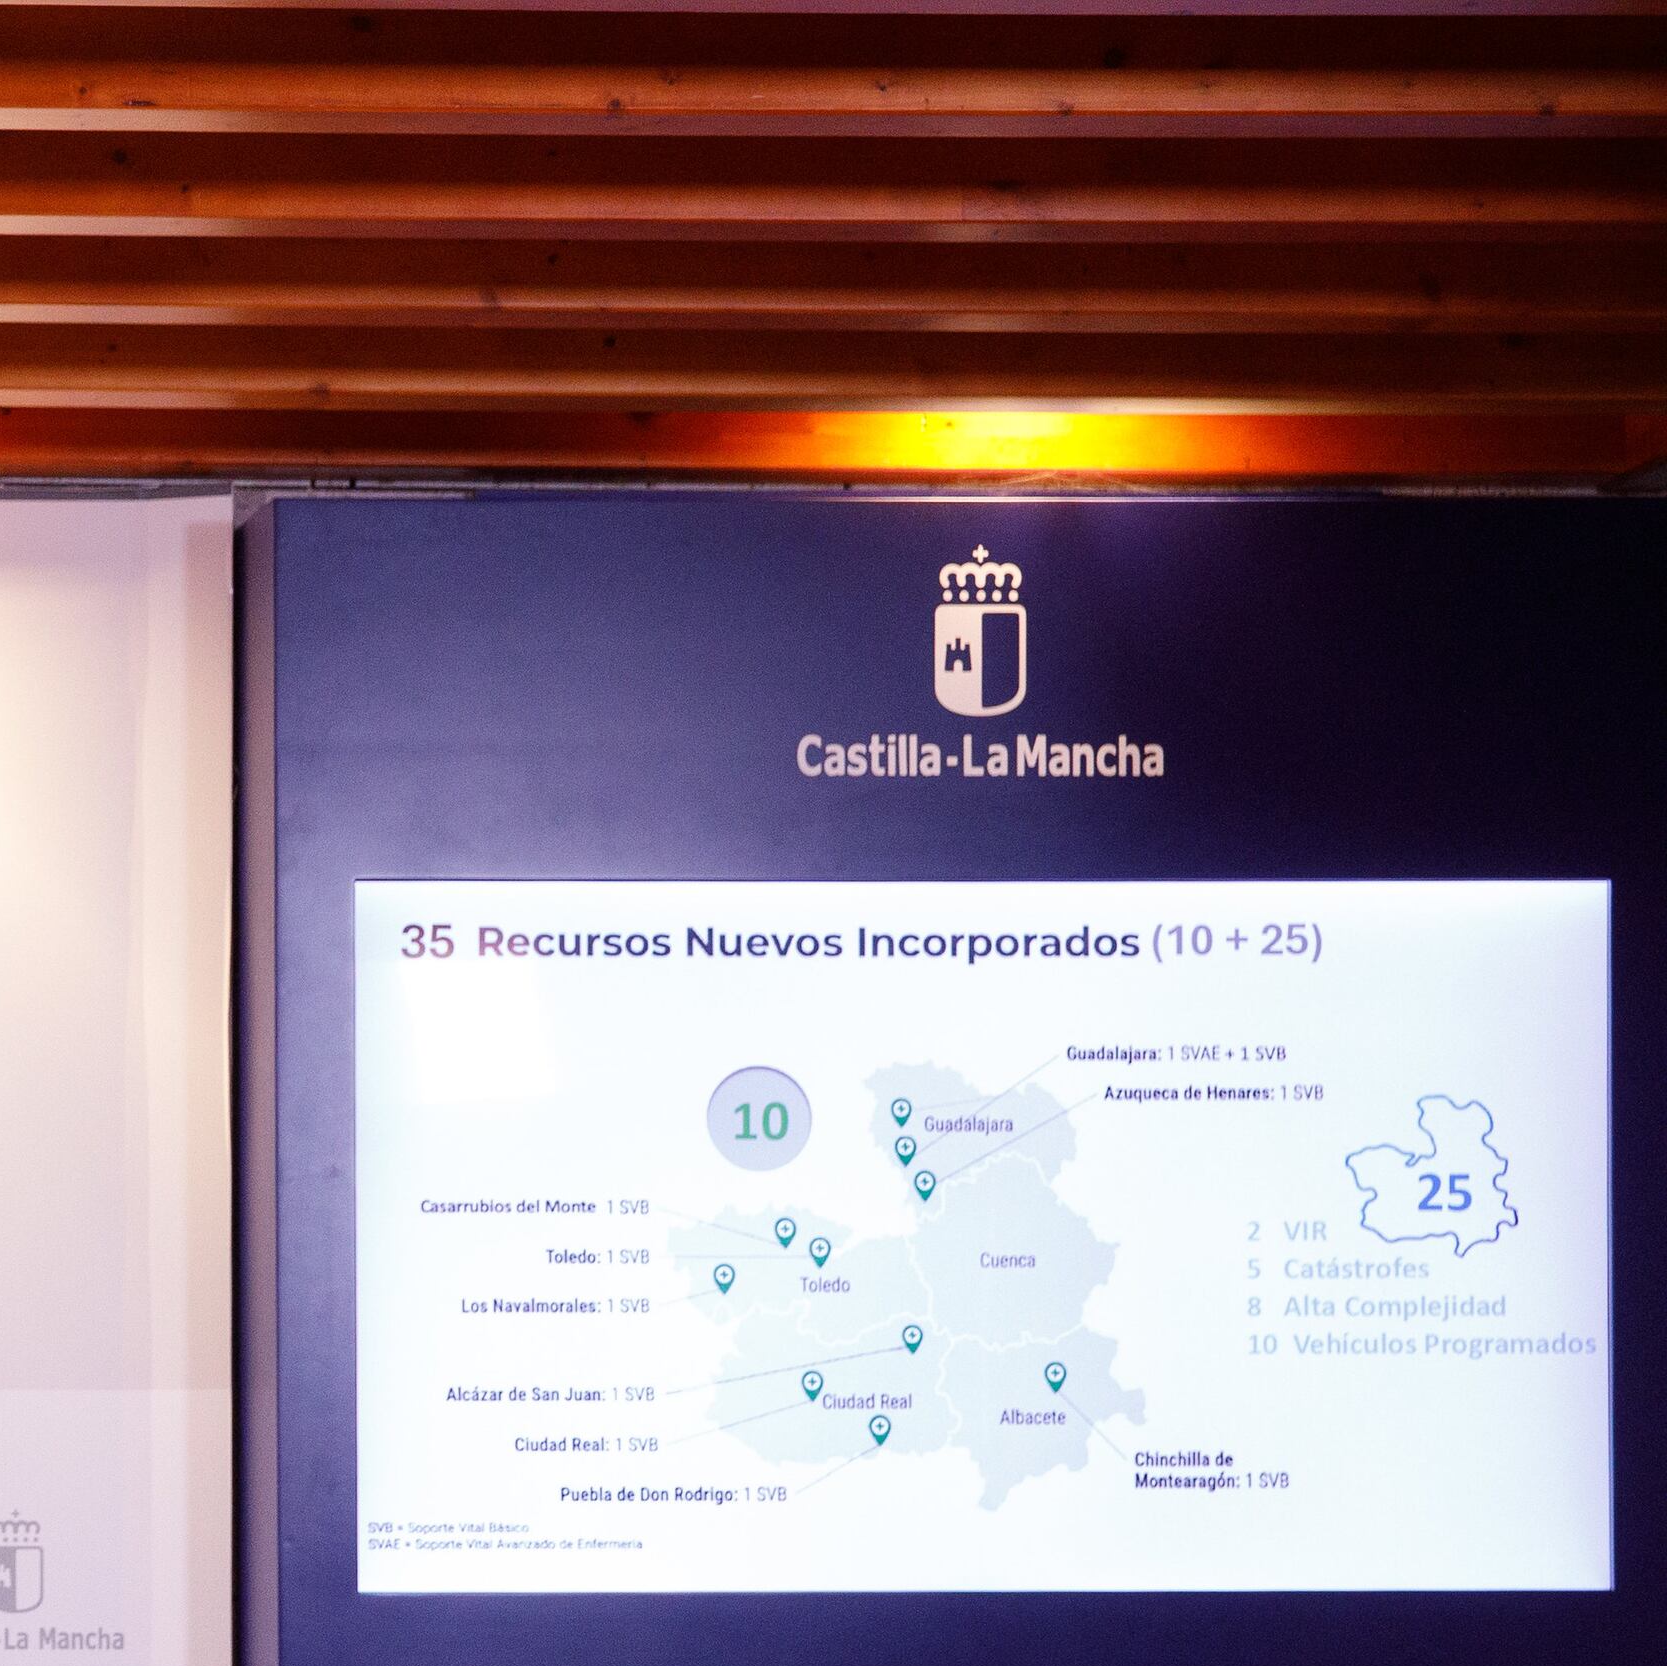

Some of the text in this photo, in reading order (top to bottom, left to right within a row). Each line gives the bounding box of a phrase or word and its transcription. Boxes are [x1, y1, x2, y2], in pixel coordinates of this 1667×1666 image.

[797, 734, 1164, 777] Castilla-La Mancha
[402, 924, 1322, 964] 35 Recursos Nuevos Incorporados (10 + 25)
[1067, 1045, 1286, 1064] Guadalajara: 1 SVAE + 1 SVB
[1104, 1085, 1323, 1103] Azuqueca de Henares: 1 SVB
[735, 1102, 789, 1140] 10
[924, 1114, 1014, 1134] Guadalajara
[1418, 1173, 1472, 1211] 25
[421, 1199, 649, 1215] Casarrubios del Monte 1 SVB
[1248, 1221, 1327, 1241] 2 VIR
[547, 1249, 649, 1264] Toledo: 1 SVB
[980, 1252, 1036, 1268] Cuenca
[1248, 1256, 1429, 1279] 5 Catástrofes
[801, 1277, 850, 1293] Toledo
[462, 1298, 650, 1313] Los Navalmorales: 1 SVB
[1247, 1295, 1506, 1321] 8 Alta Complejidad
[1250, 1332, 1597, 1360] 10 Vehículos Programados
[446, 1386, 655, 1401] Alcázar de San Juan: 1 SVB
[821, 1393, 913, 1411] Ciudad Real
[999, 1408, 1067, 1426] Albacete
[515, 1437, 658, 1452] Ciudad Real: 1 SVB
[1135, 1451, 1233, 1467] Chinchilla de
[1135, 1472, 1289, 1492] Montearagón: 1 SVB
[561, 1486, 787, 1506] Puebla de Don Rodrigo: 1 SVB
[39, 1627, 124, 1650] Mancha
